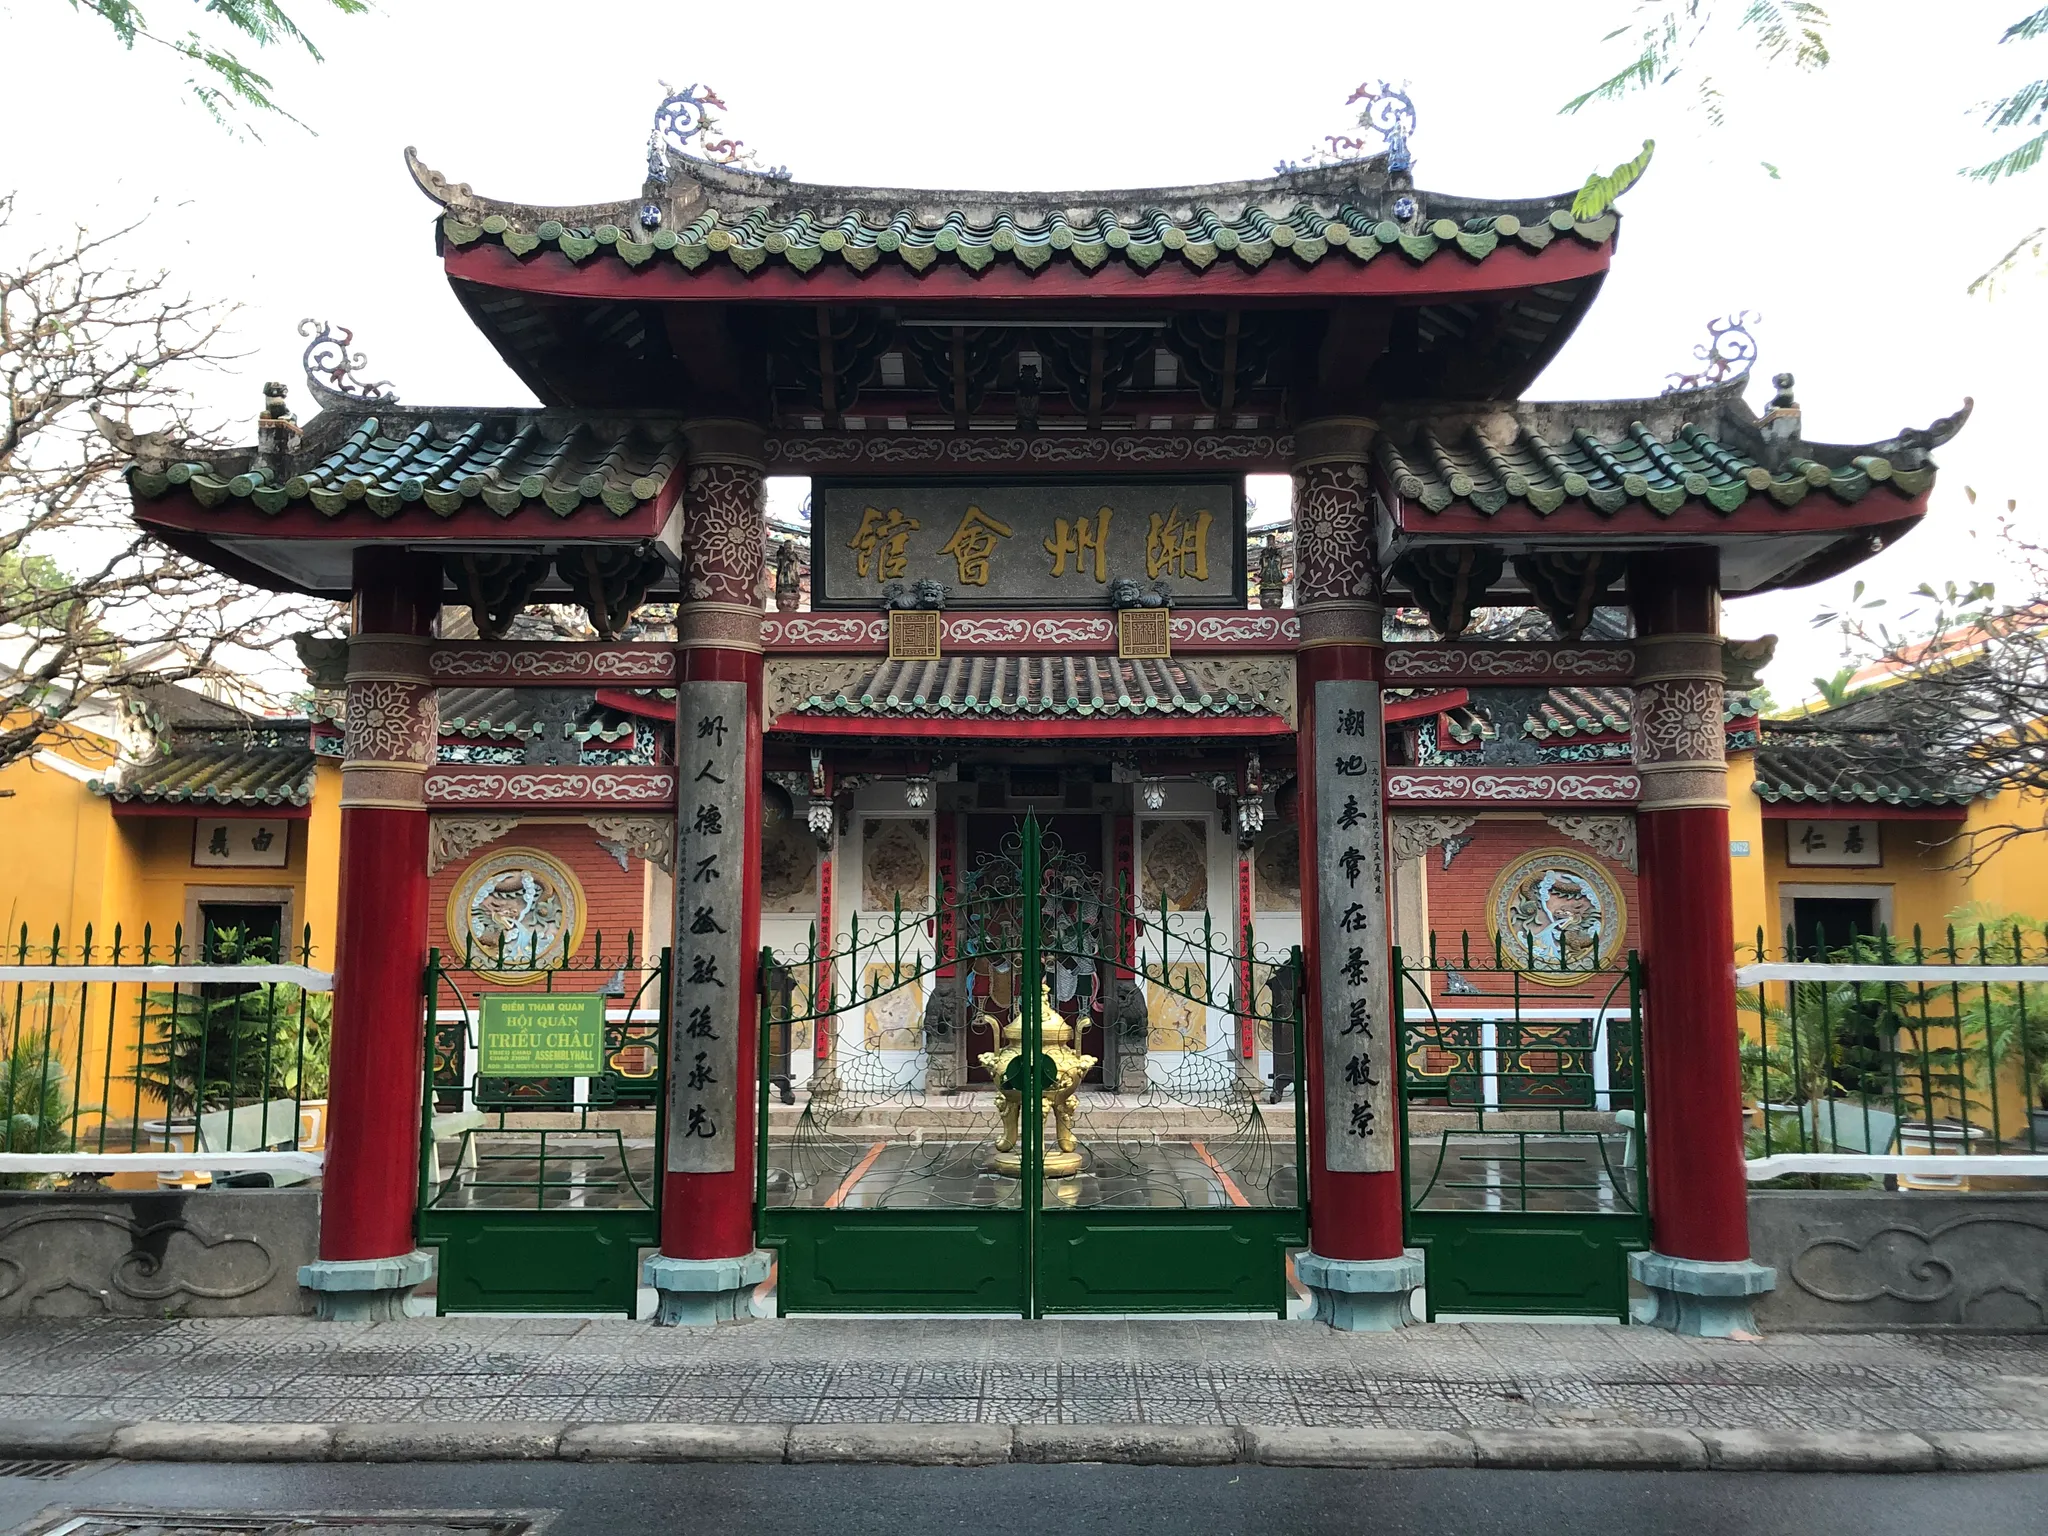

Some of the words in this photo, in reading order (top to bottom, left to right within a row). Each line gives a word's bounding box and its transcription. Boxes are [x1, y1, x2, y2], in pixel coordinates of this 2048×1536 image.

[846, 503, 1213, 587] 潮州會館
[1730, 841, 1749, 852] 362
[528, 1003, 555, 1012] THAM
[558, 1003, 585, 1012] QUAN
[546, 1029, 596, 1048] CHÂU
